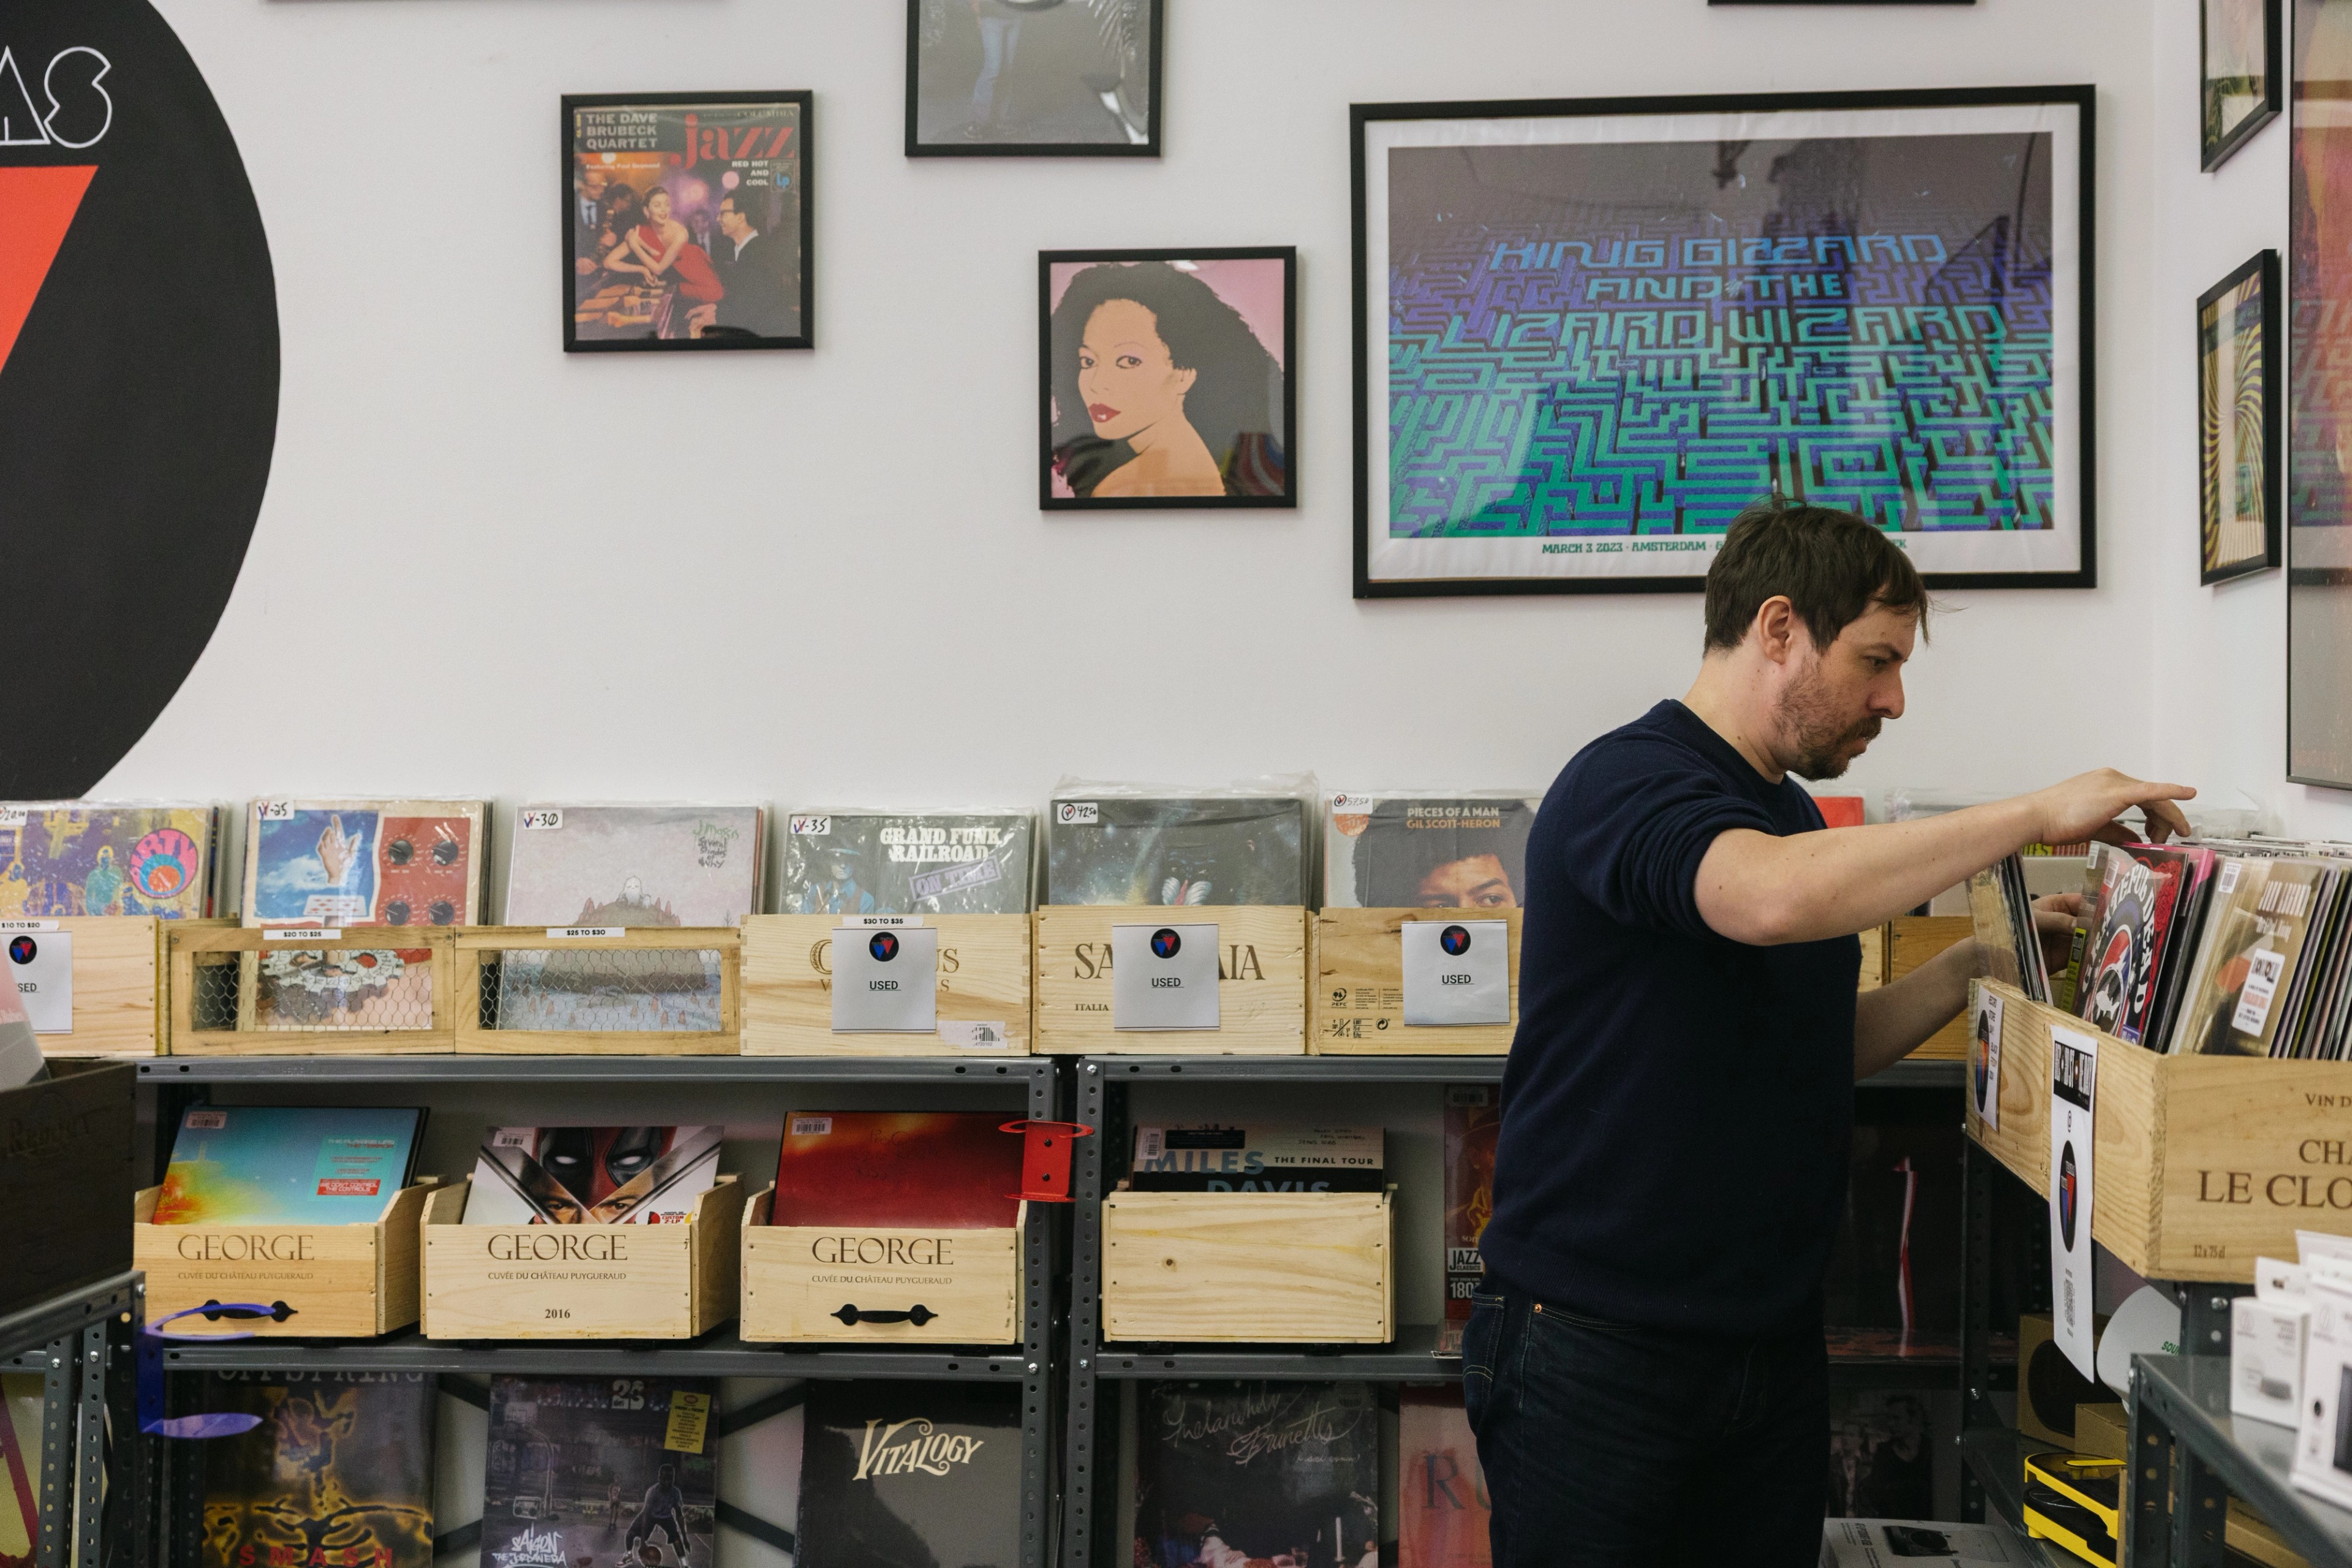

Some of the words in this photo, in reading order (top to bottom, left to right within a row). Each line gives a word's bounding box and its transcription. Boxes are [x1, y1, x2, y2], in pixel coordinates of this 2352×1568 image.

[586, 114, 616, 124] THE
[620, 113, 658, 124] DAVE
[586, 125, 657, 136] BRUBECK
[586, 138, 658, 150] QUARTET
[669, 113, 794, 170] jazz
[1490, 240, 1666, 270] KING
[1683, 234, 1947, 267] GIZZARD
[1586, 274, 1722, 301] AND
[1744, 273, 1843, 297] THE
[1439, 309, 1706, 352] LIZARD
[1726, 305, 2007, 344] WIZARD
[1542, 543, 1582, 554] MARCH
[1585, 543, 1593, 553] 3
[1596, 542, 1623, 552] 2023
[1632, 541, 1706, 552] AMSTERDAM
[1408, 807, 1444, 817] PIECES
[1445, 807, 1460, 816] OF
[1463, 807, 1470, 816] A
[1472, 807, 1499, 816] MAN
[1407, 820, 1424, 828] GIL
[1426, 819, 1501, 829] SCOTT-HERON
[880, 827, 946, 845] GRAND
[949, 827, 1001, 845] FUNK
[889, 845, 989, 862] RAILROAD
[916, 875, 942, 895] ON
[944, 861, 995, 886] TIME
[869, 981, 899, 990] USED
[1152, 978, 1181, 987] USED
[1442, 974, 1471, 984] USED
[17, 982, 37, 992] SED
[2305, 1093, 2334, 1107] VIN
[1143, 1150, 1265, 1175] MILES
[2196, 1169, 2253, 1204] LE
[178, 1234, 314, 1261] GEORGE
[488, 1234, 628, 1261] GEORGE
[812, 1236, 954, 1265] GEORGE
[1450, 1250, 1480, 1271] JAZZ
[178, 1271, 203, 1280] CUVÉE
[219, 1271, 257, 1280] CHÂTEAU
[488, 1270, 514, 1280] CUVÉE
[530, 1270, 568, 1280] CHÂTEAU
[571, 1272, 627, 1281] PUYGUERAUD
[812, 1273, 838, 1283] CUVÉE
[854, 1273, 893, 1284] CHÂTEAU
[895, 1276, 952, 1285] PUYGUERAUD
[545, 1308, 571, 1319] 2016
[852, 1417, 984, 1480] VITALOGY
[239, 1545, 393, 1568] SMASH
[491, 1553, 509, 1561] THE
